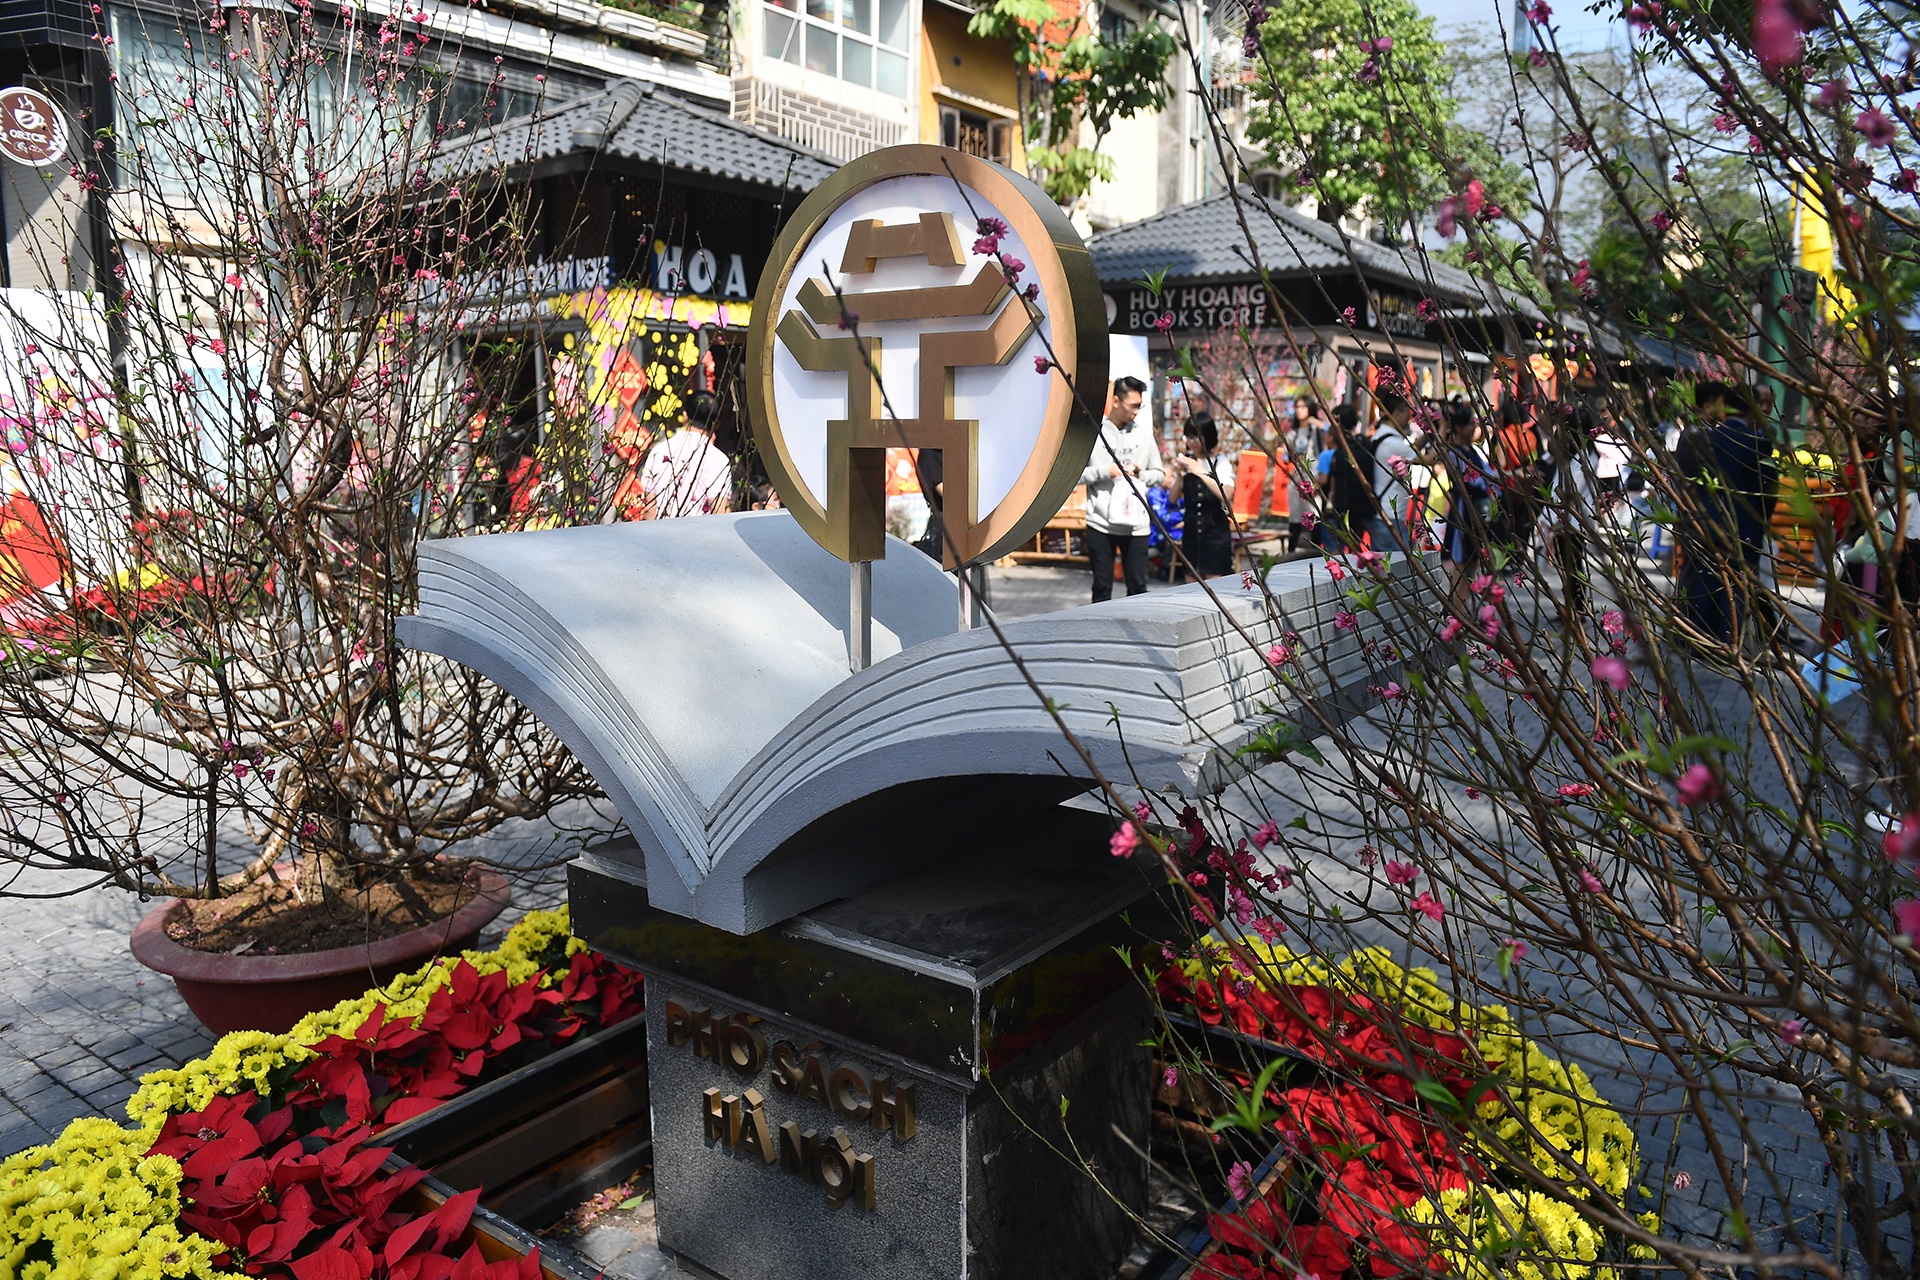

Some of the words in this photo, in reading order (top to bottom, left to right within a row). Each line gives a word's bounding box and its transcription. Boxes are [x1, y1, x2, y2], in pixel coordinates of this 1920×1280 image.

[655, 246, 748, 297] HOA
[1130, 290, 1176, 311] HUY
[1181, 284, 1266, 308] HOANG
[1130, 306, 1266, 329] BOOKSTORE
[771, 1038, 916, 1141] SÁCH
[703, 1087, 776, 1164] HÀ
[779, 1120, 875, 1211] NỘI
